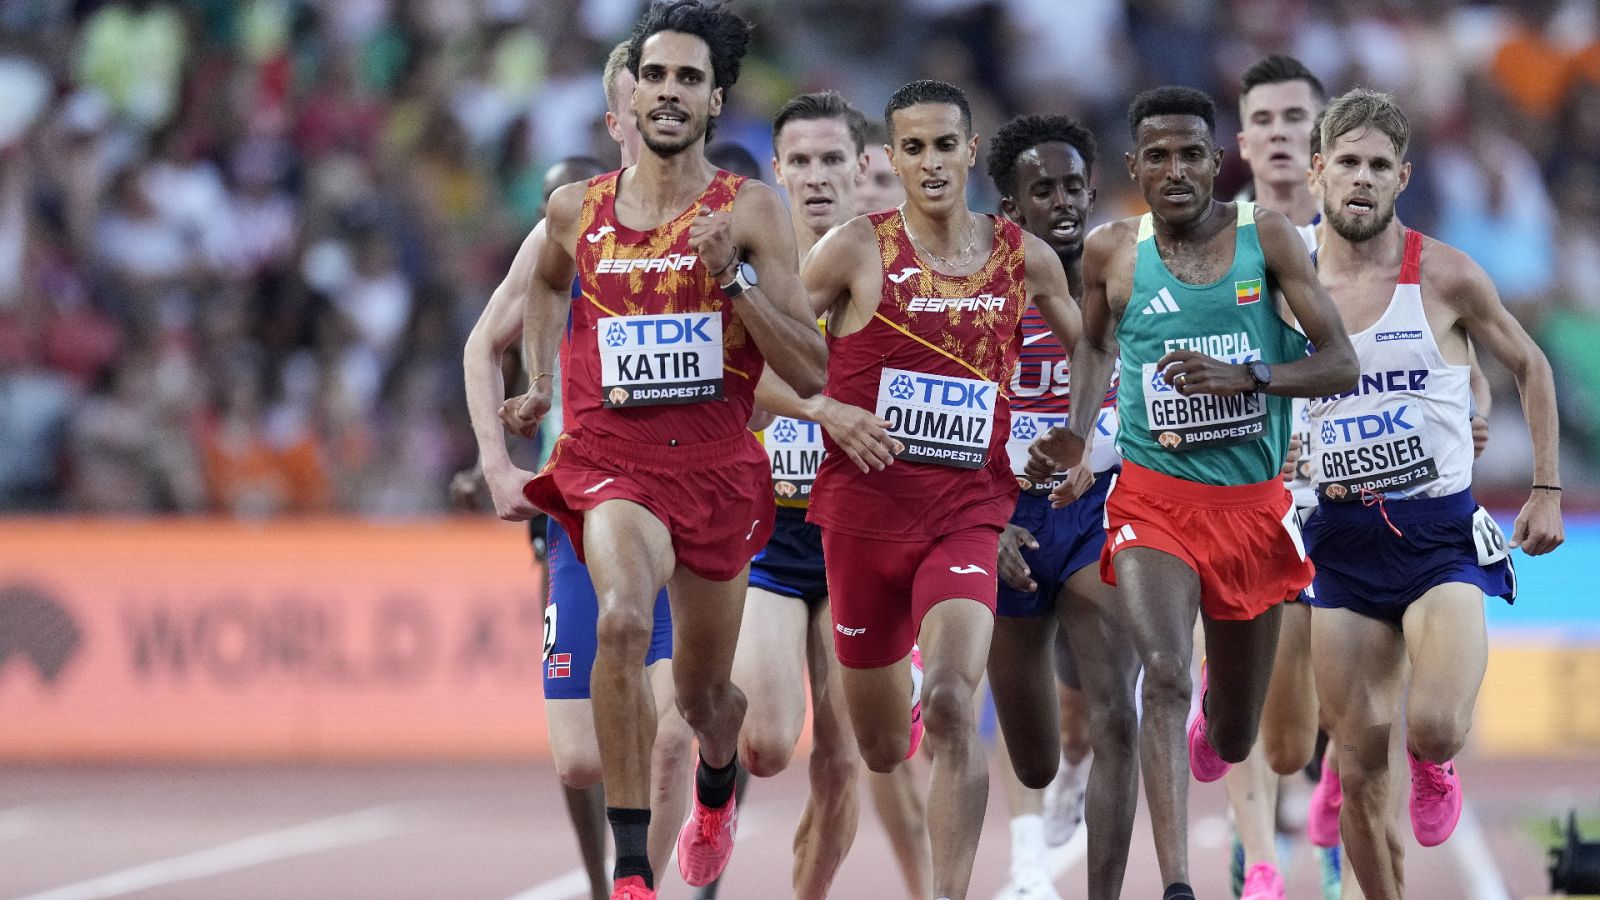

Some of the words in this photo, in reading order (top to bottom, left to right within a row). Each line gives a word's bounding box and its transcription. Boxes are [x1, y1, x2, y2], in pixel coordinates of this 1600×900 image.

[595, 253, 698, 273] ESPAÑA
[907, 293, 1006, 312] ESPAÑA
[626, 317, 712, 345] TDK
[1401, 331, 1422, 340] Mutuel
[1164, 331, 1251, 360] ETHIOPIA
[616, 351, 700, 381] KATIR
[633, 386, 701, 400] BUDAPEST
[702, 384, 716, 396] 23
[915, 376, 990, 410] TDK
[884, 405, 987, 444] OUMAIZ
[1185, 424, 1252, 443] BUDAPEST
[1252, 421, 1263, 434] 23
[1334, 404, 1415, 443] TDK
[772, 450, 828, 475] ALM
[909, 444, 972, 463] BUDAPEST
[971, 453, 983, 464] 23
[1322, 435, 1425, 479] GRESSIER
[1350, 470, 1413, 495] BUDAPEST
[1414, 466, 1429, 479] 23
[1474, 515, 1506, 558] 18
[836, 623, 867, 636] ESP
